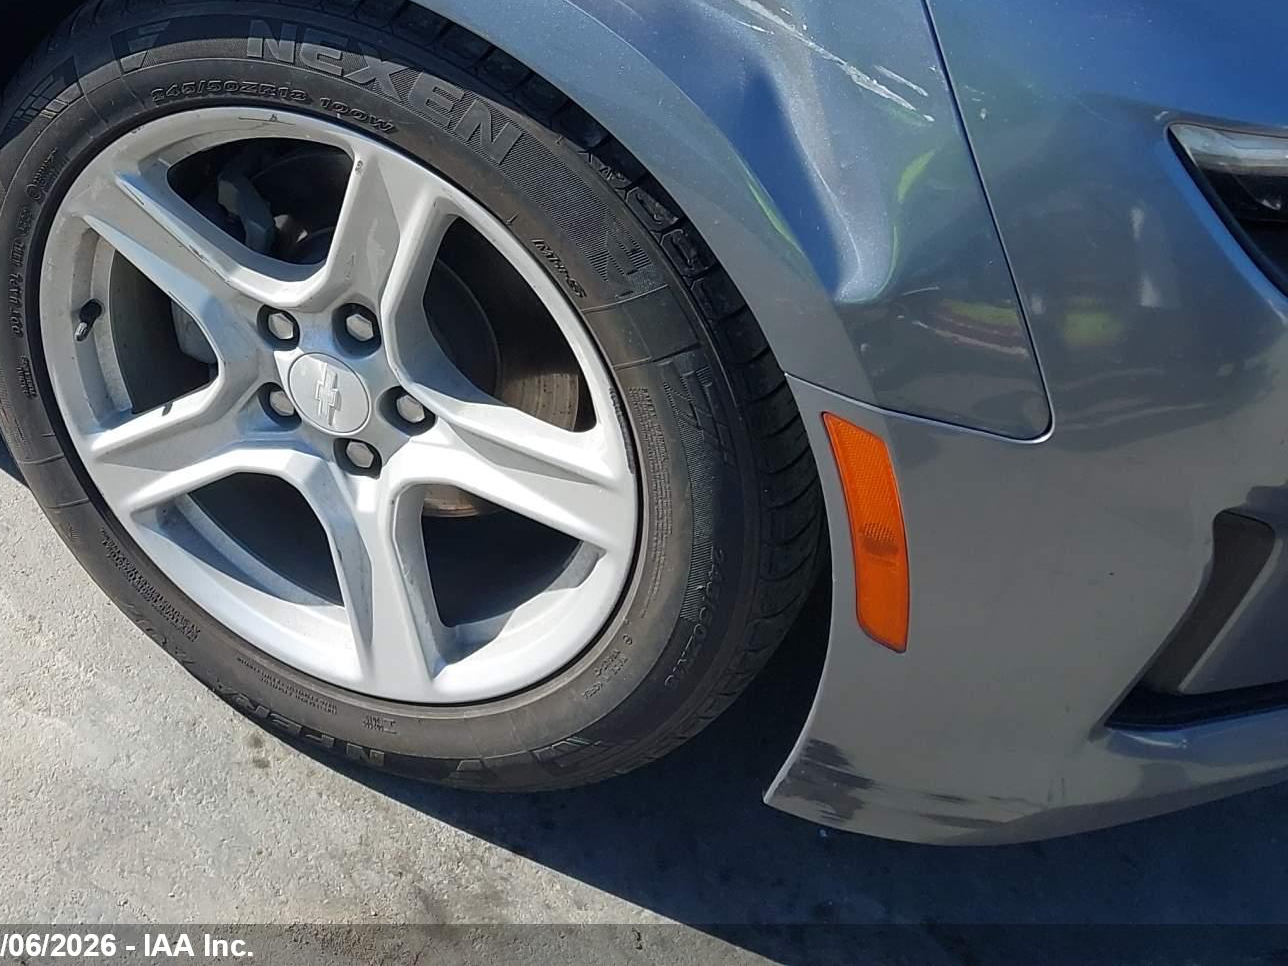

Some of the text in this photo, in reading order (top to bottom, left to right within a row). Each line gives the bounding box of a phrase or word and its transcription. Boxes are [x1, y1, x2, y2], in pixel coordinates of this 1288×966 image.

[150, 80, 397, 134] 245/50ZR18 100W
[245, 18, 525, 166] NEXEN
